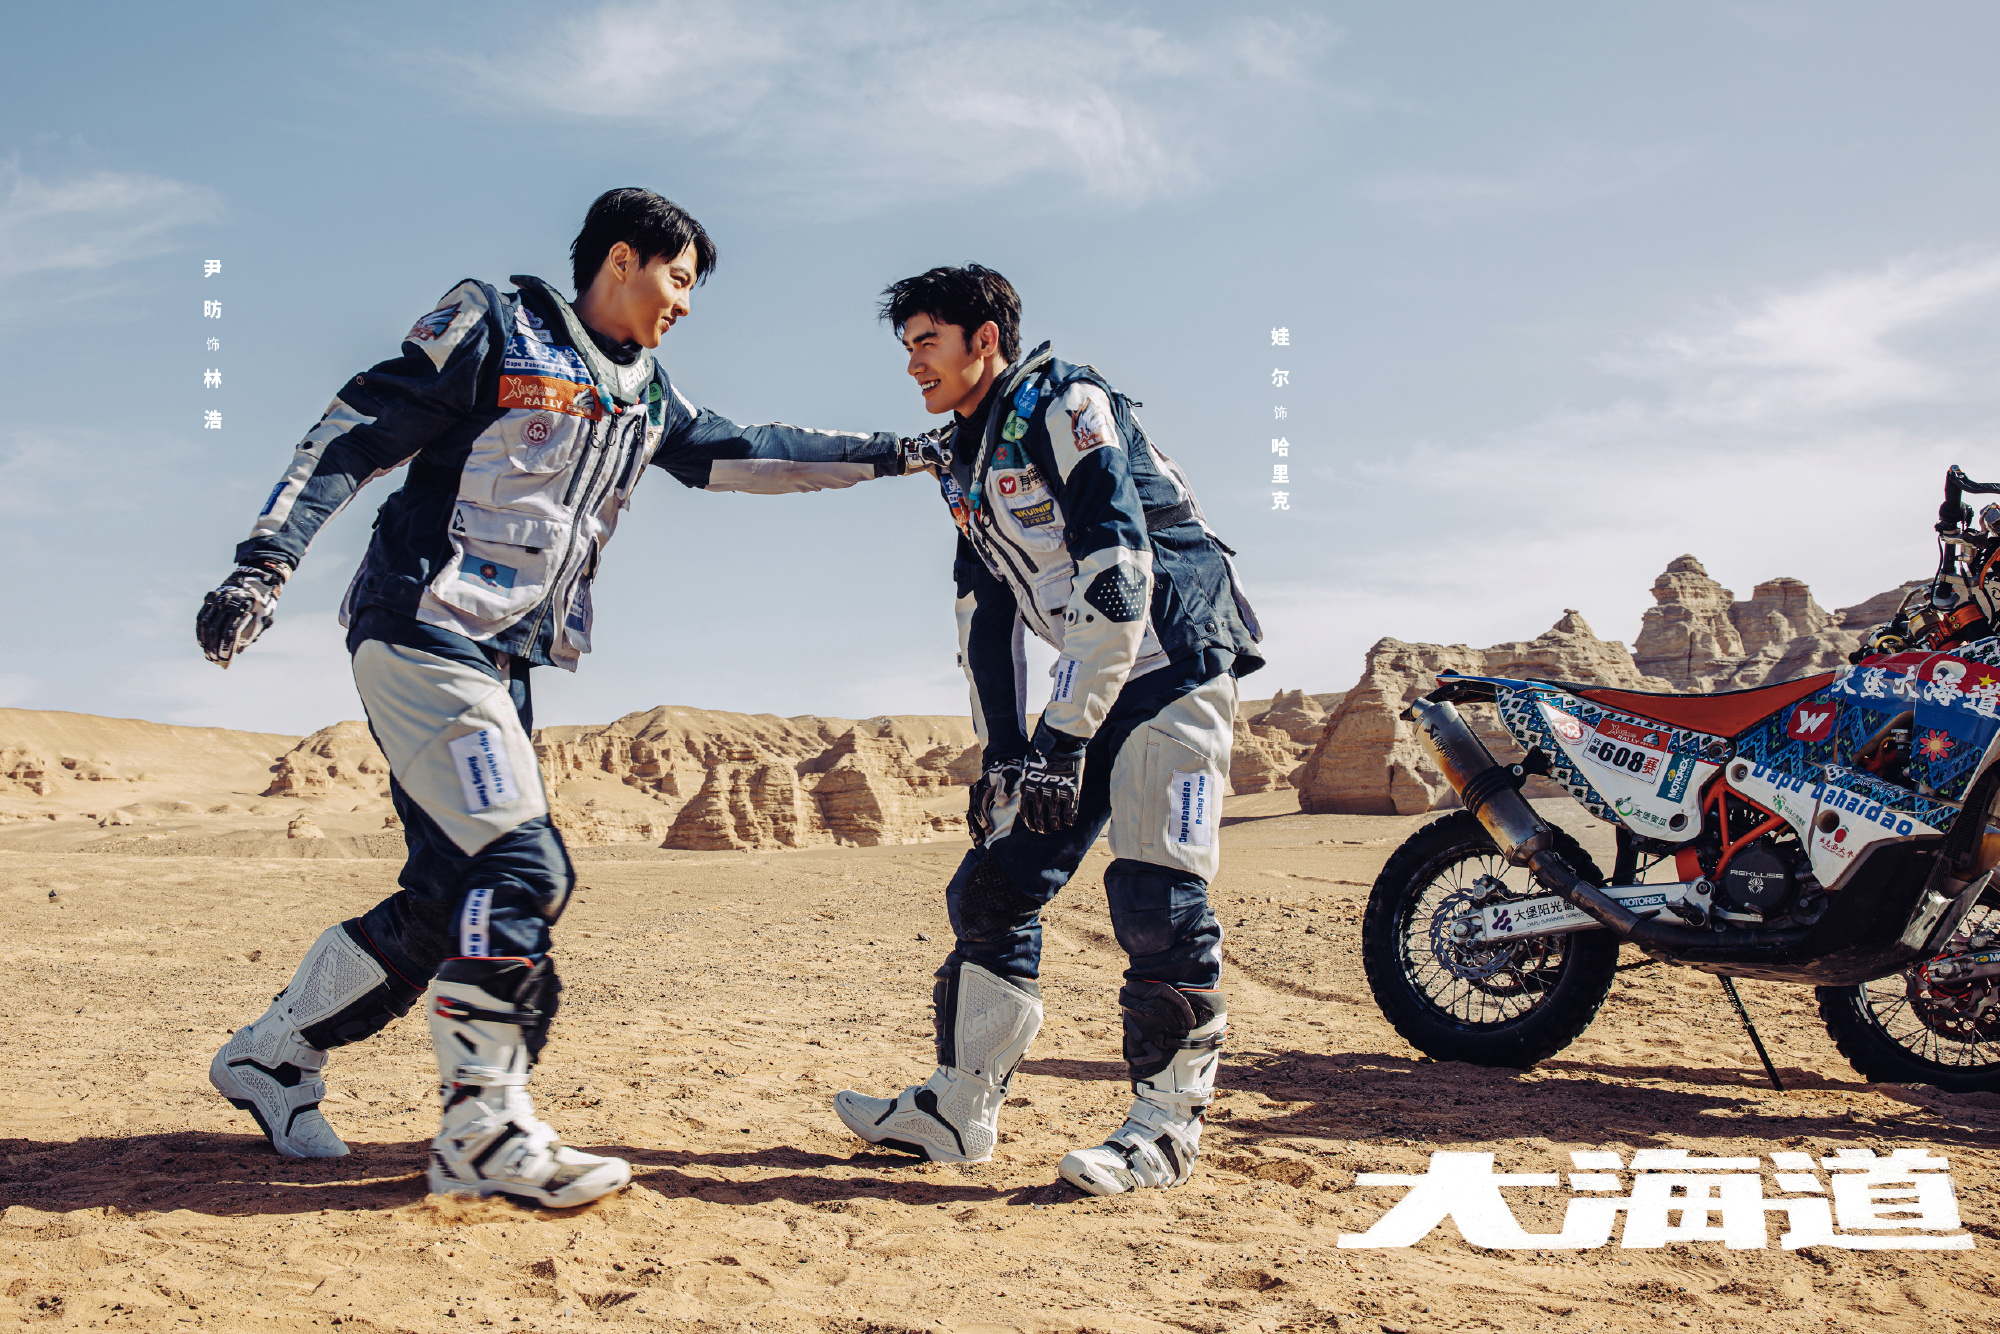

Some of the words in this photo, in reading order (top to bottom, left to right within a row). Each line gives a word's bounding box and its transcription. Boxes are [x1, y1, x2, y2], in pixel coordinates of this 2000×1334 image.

[524, 397, 563, 409] RALLY
[1617, 735, 1640, 745] RALLY
[1598, 741, 1645, 773] 608
[1026, 770, 1075, 787] GPX
[1197, 775, 1206, 797] Team
[1668, 756, 1691, 799] MOTOREX
[1181, 781, 1191, 822] Dahaidao
[1751, 761, 1806, 794] Dapu
[1810, 782, 1913, 836] Dahaidao
[1195, 797, 1205, 825] Racing
[1179, 822, 1190, 843] Dapu
[1618, 894, 1664, 907] MOTOREX
